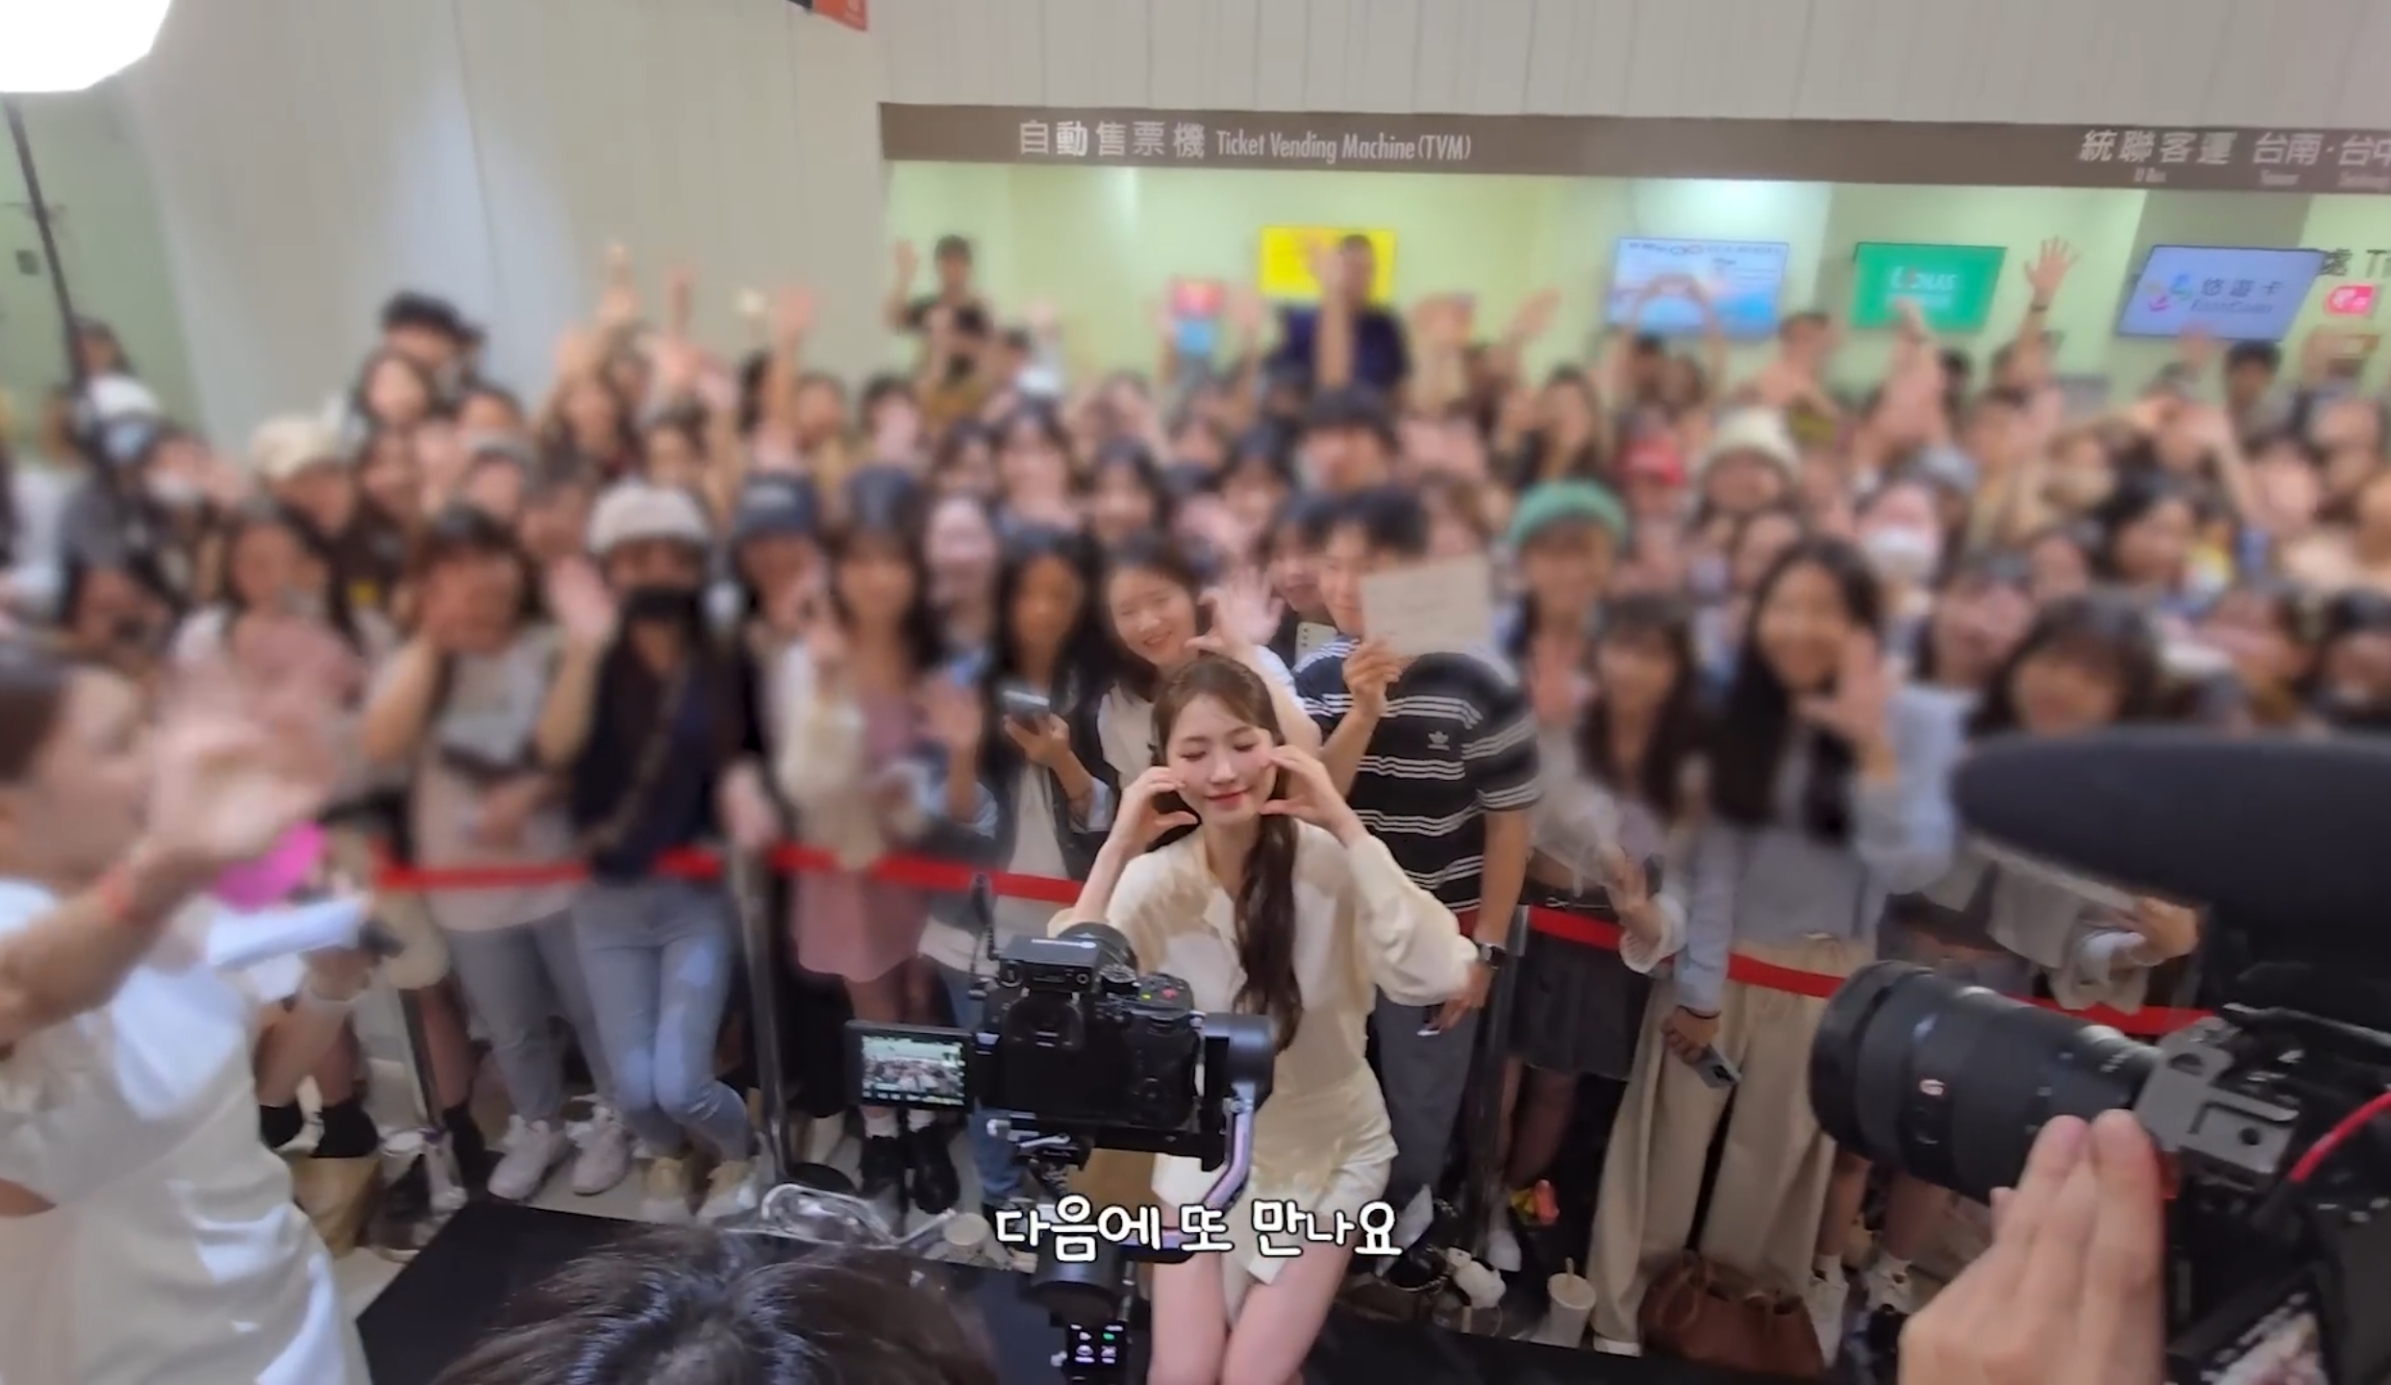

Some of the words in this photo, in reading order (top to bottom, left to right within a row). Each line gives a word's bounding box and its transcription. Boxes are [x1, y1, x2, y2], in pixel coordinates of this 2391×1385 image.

[1019, 119, 1205, 158] 自動售票機
[1216, 129, 1266, 156] Ticket
[1270, 131, 1337, 164] Vending
[1341, 132, 1415, 159] Machine
[1418, 135, 1472, 160] (TVM)
